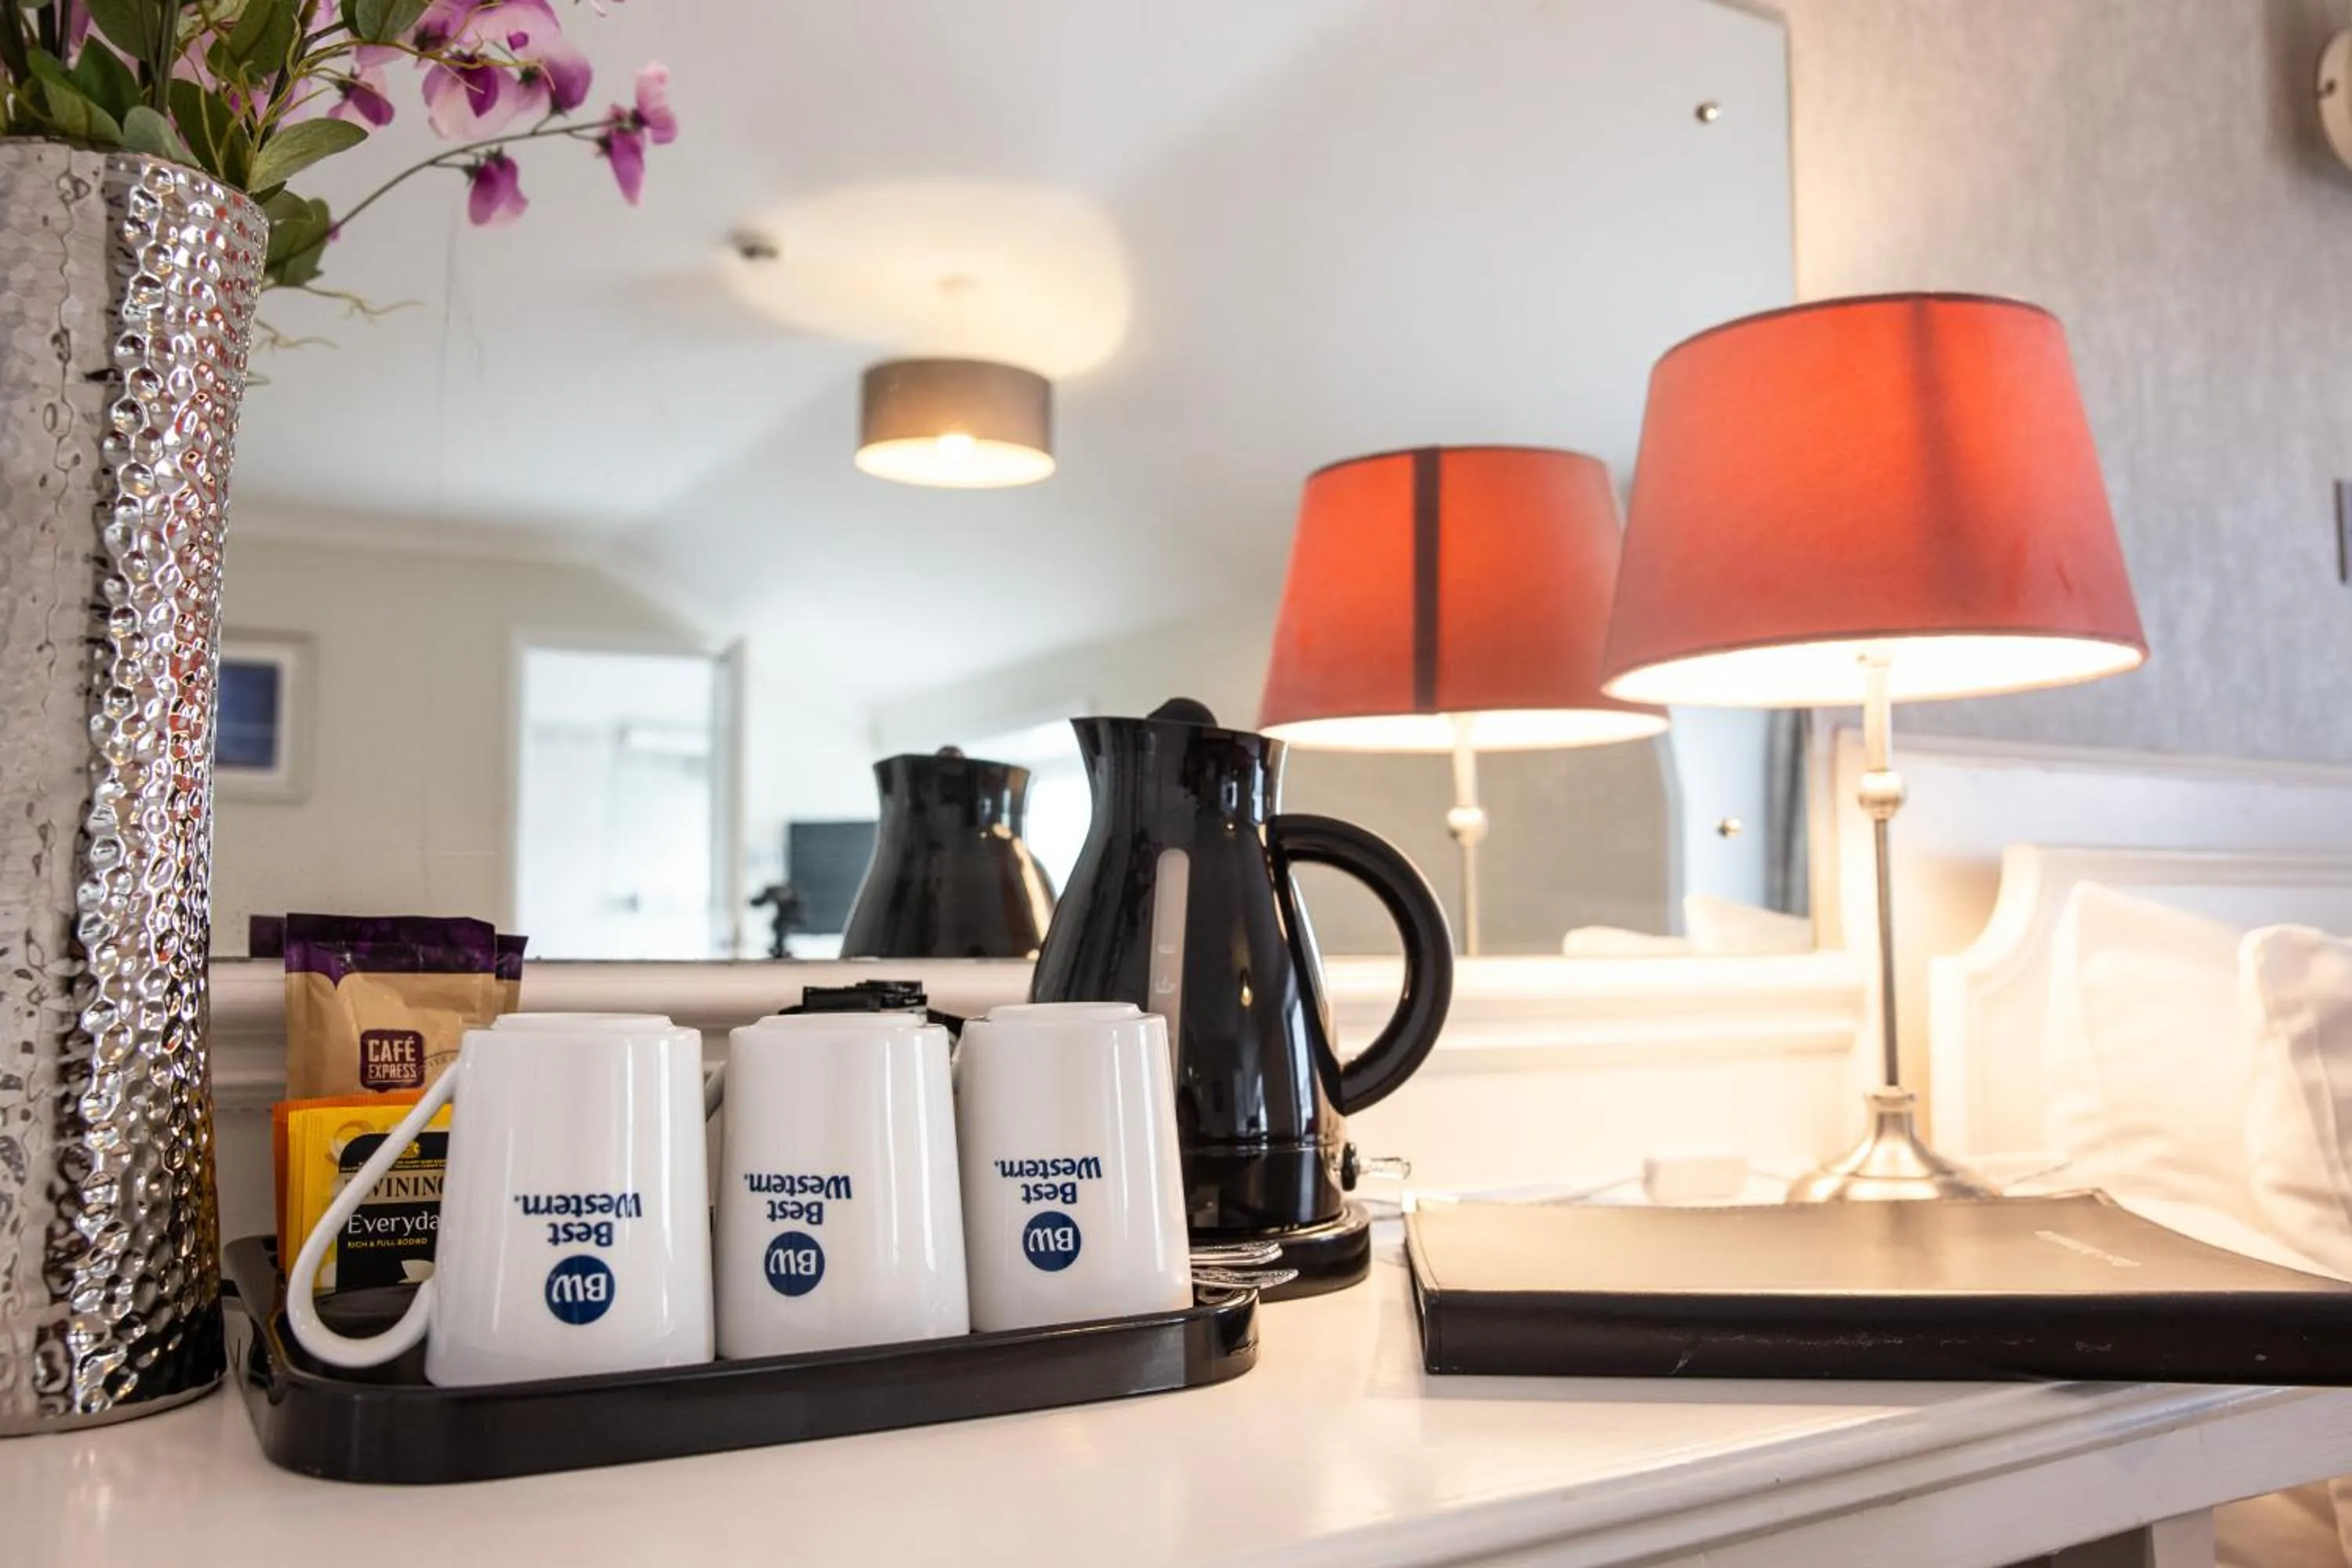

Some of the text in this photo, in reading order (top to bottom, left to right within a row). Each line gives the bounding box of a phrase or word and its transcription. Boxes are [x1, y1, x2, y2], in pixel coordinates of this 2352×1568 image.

[368, 1036, 416, 1062] CAFÉ
[368, 1063, 416, 1079] EXPRESS
[1021, 1181, 1077, 1204] Best
[347, 1210, 440, 1236] Everyda
[767, 1200, 824, 1225] Best
[376, 1239, 395, 1247] FULL
[547, 1221, 613, 1247] Best
[1028, 1226, 1074, 1252] BW
[769, 1248, 817, 1276] BW
[551, 1272, 607, 1303] BW
